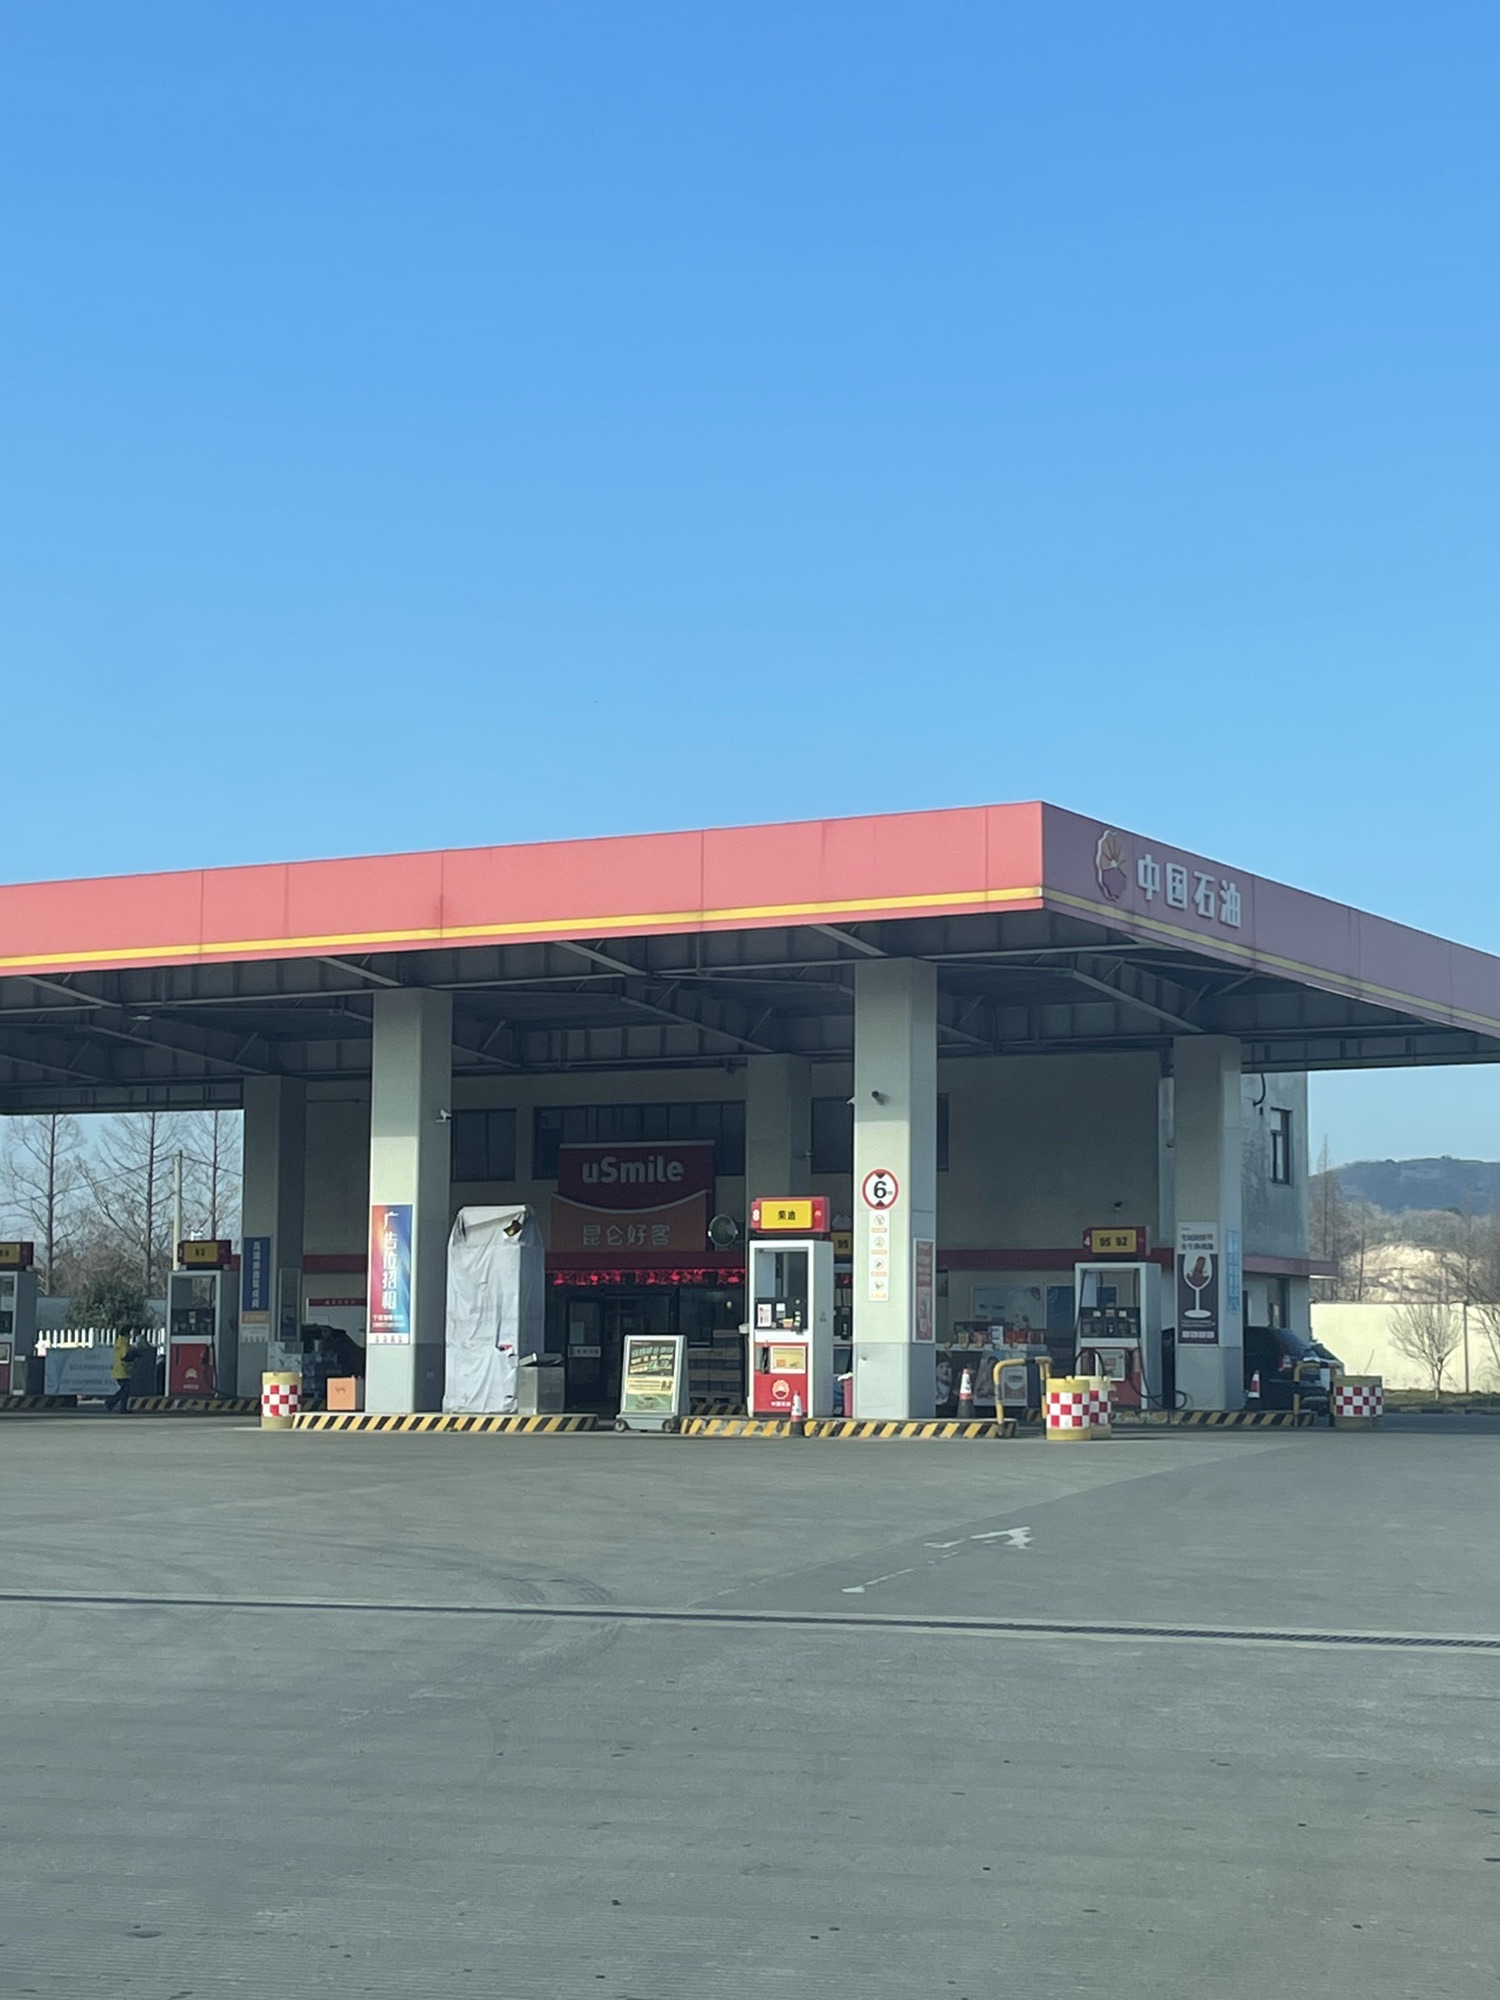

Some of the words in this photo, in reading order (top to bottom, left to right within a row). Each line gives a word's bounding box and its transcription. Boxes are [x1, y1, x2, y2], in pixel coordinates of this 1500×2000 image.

[1137, 854, 1242, 928] 中国石油
[582, 1155, 684, 1183] uSmile
[873, 1181, 887, 1199] 6
[752, 1209, 760, 1221] 8
[582, 1224, 670, 1246] 昆仑好客
[382, 1211, 399, 1310] 广告位招租
